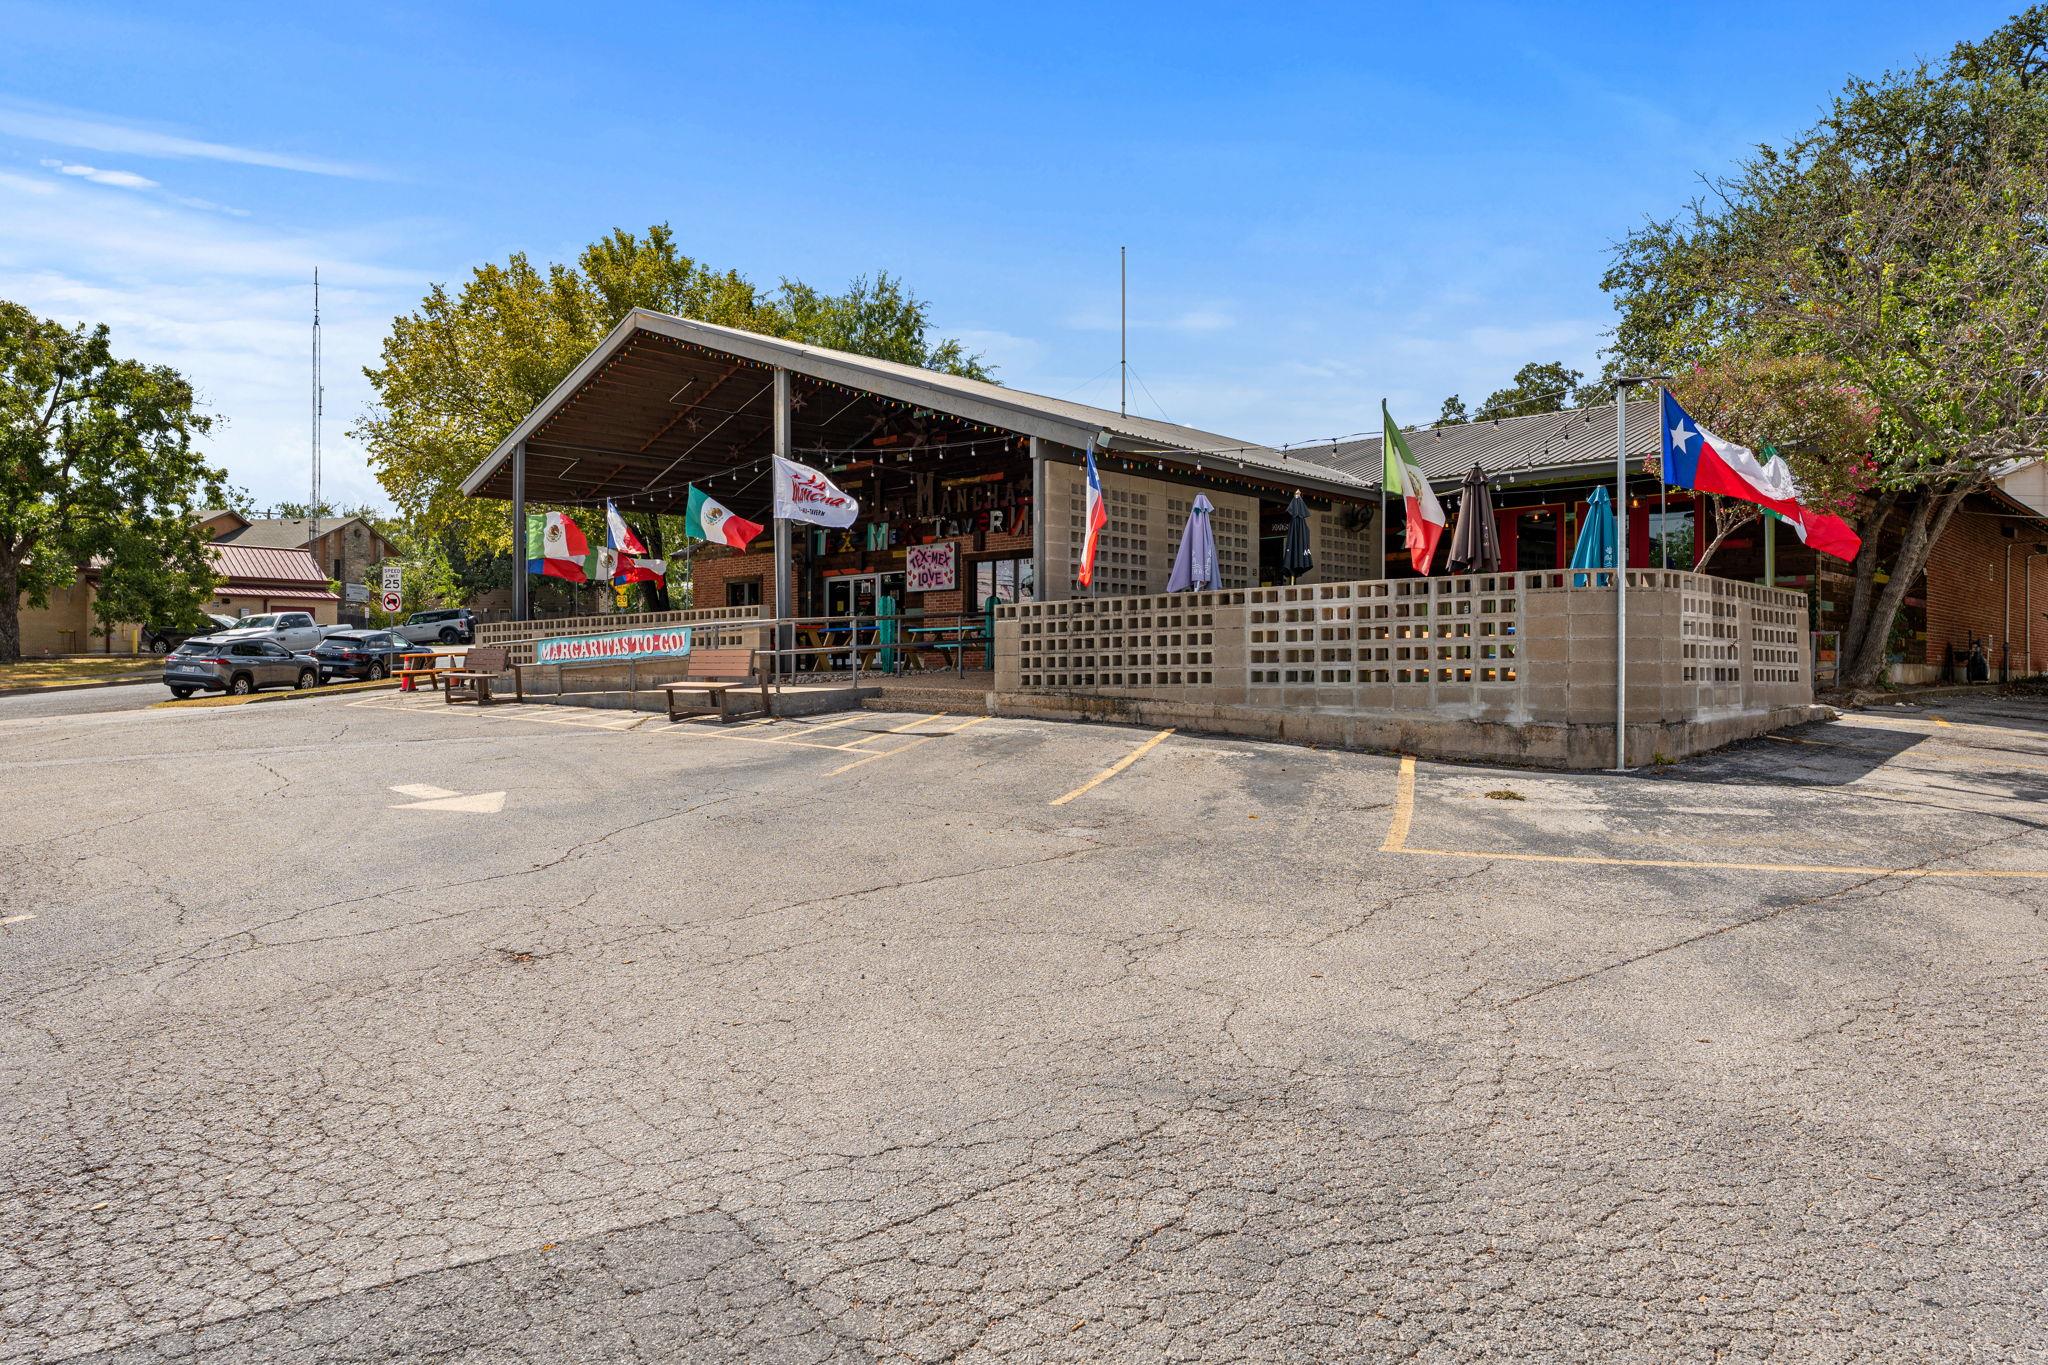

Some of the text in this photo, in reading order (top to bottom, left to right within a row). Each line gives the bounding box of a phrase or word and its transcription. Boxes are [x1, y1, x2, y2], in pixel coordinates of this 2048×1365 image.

[916, 472, 1016, 517] MANCHA
[933, 505, 1030, 538] TAVERN
[910, 550, 950, 569] TEX-MEX
[384, 579, 400, 589] 25
[918, 569, 944, 587] LOVE
[541, 631, 686, 660] MARGARITAS TO-GO!
